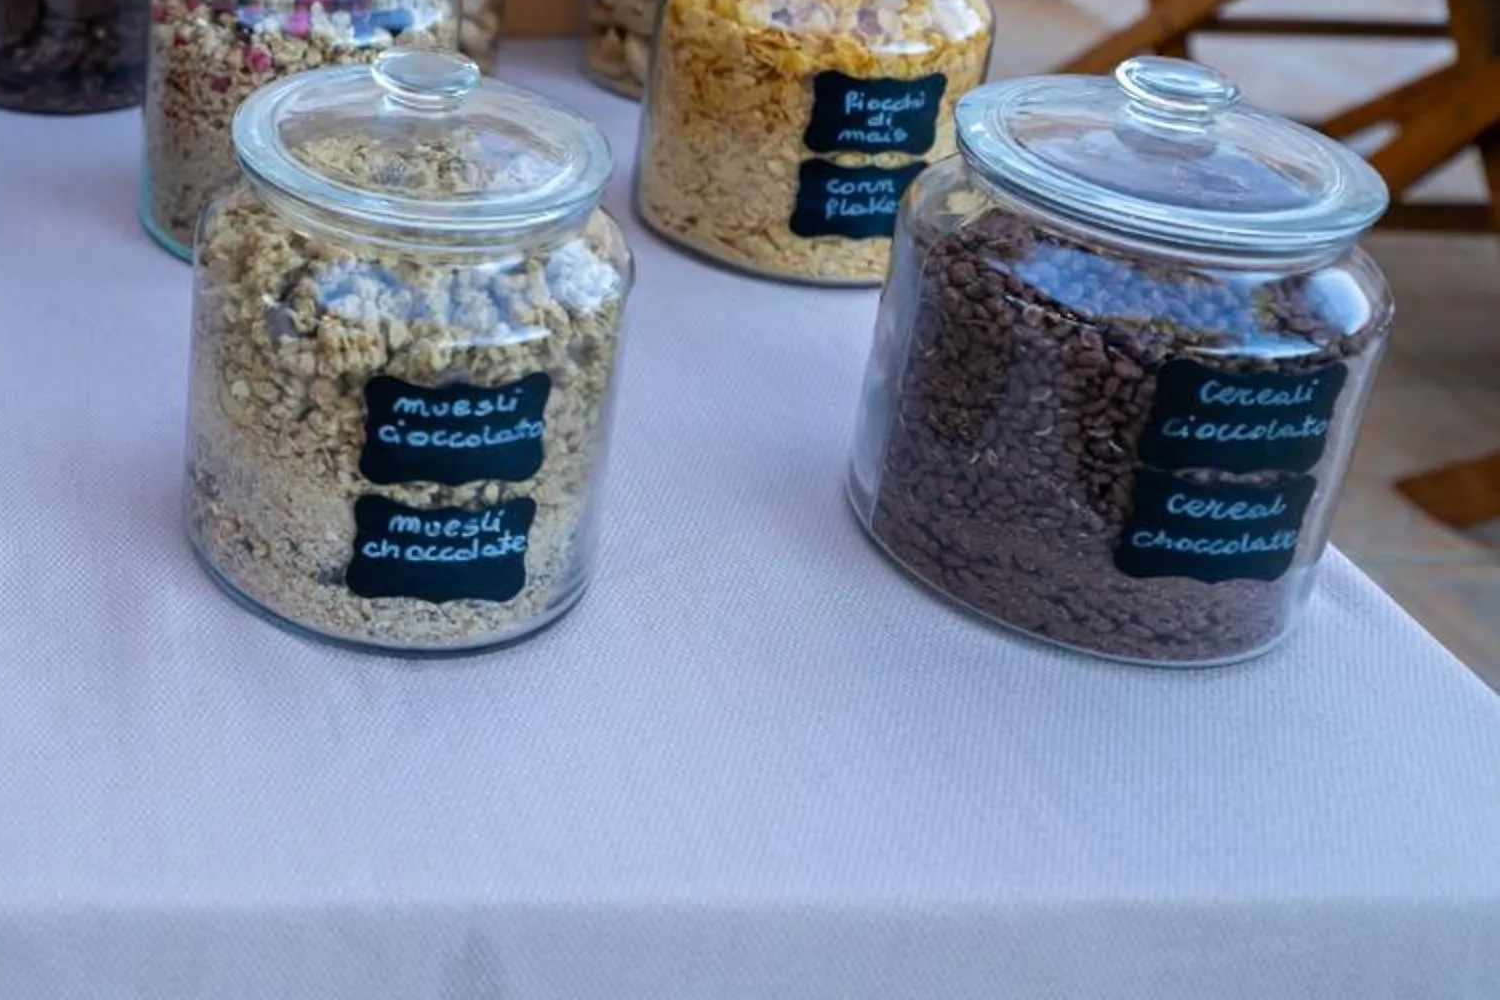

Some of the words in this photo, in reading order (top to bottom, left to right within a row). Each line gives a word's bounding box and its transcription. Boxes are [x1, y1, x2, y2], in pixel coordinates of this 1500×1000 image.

[867, 112, 893, 127] di
[825, 178, 896, 196] corn
[392, 388, 524, 418] muesli
[388, 509, 506, 538] muesli
